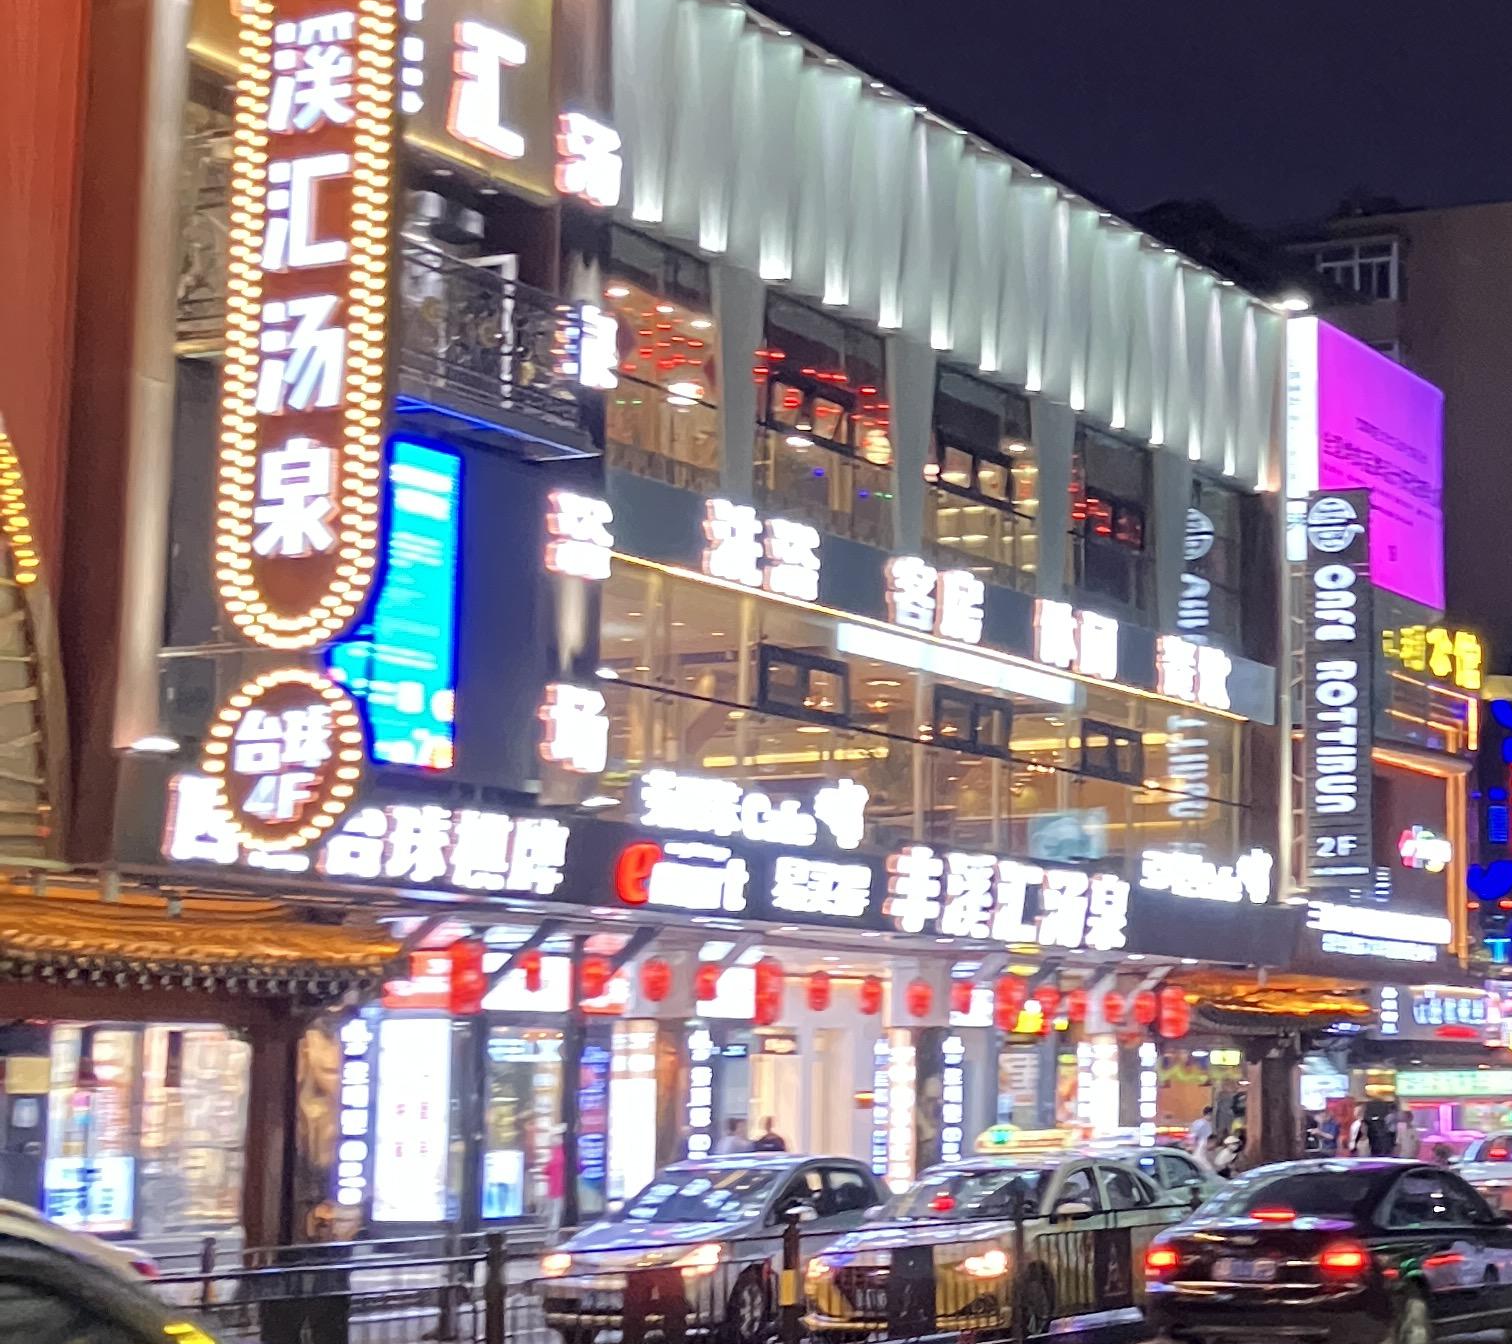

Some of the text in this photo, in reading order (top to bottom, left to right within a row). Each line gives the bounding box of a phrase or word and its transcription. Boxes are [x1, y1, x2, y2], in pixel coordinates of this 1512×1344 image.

[234, 705, 333, 774] 台球
[243, 773, 319, 820] 4F
[1315, 836, 1358, 858] 2F
[888, 847, 1130, 951] 丰溪汇汤泉
